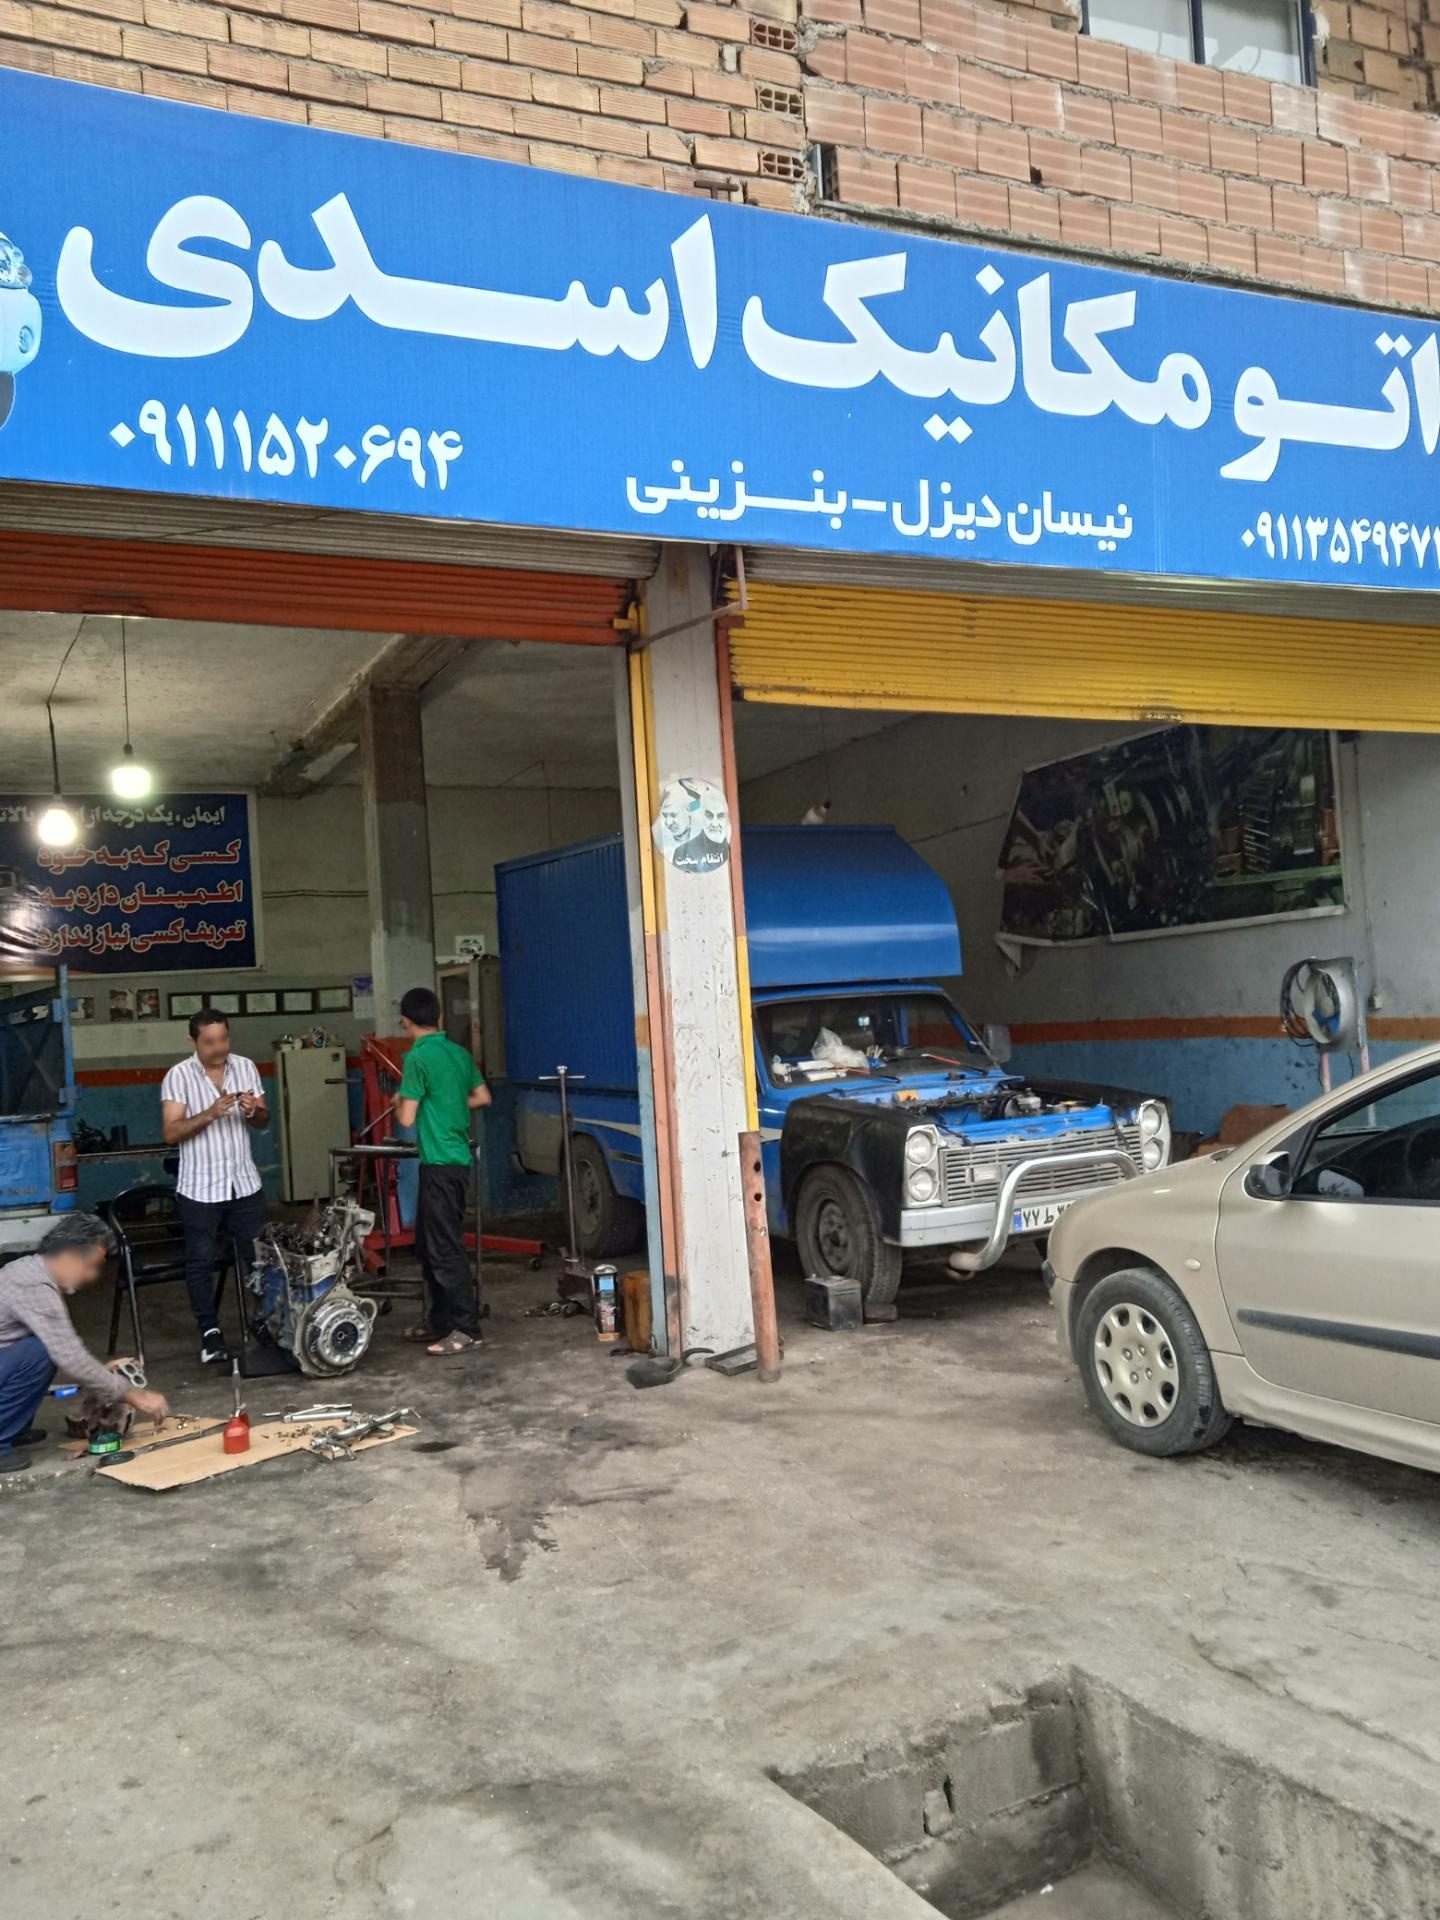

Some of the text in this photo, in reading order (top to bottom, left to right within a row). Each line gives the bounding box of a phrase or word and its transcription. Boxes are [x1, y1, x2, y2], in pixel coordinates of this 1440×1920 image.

[56, 192, 1440, 482] اتو مکانیک اسدی
[109, 399, 464, 490] ۰۹۱۱۱۵۲۰۶۹۴
[1007, 491, 1133, 552] نیسان
[0, 805, 34, 826] بالات
[102, 807, 145, 829] درجه
[146, 804, 174, 826] یک
[37, 839, 242, 875] کسی که به خود
[675, 852, 724, 866] انتقام سخت
[38, 879, 243, 915] اطمینان دارد به
[37, 917, 247, 956] تعریف کسی نیاز ندارد
